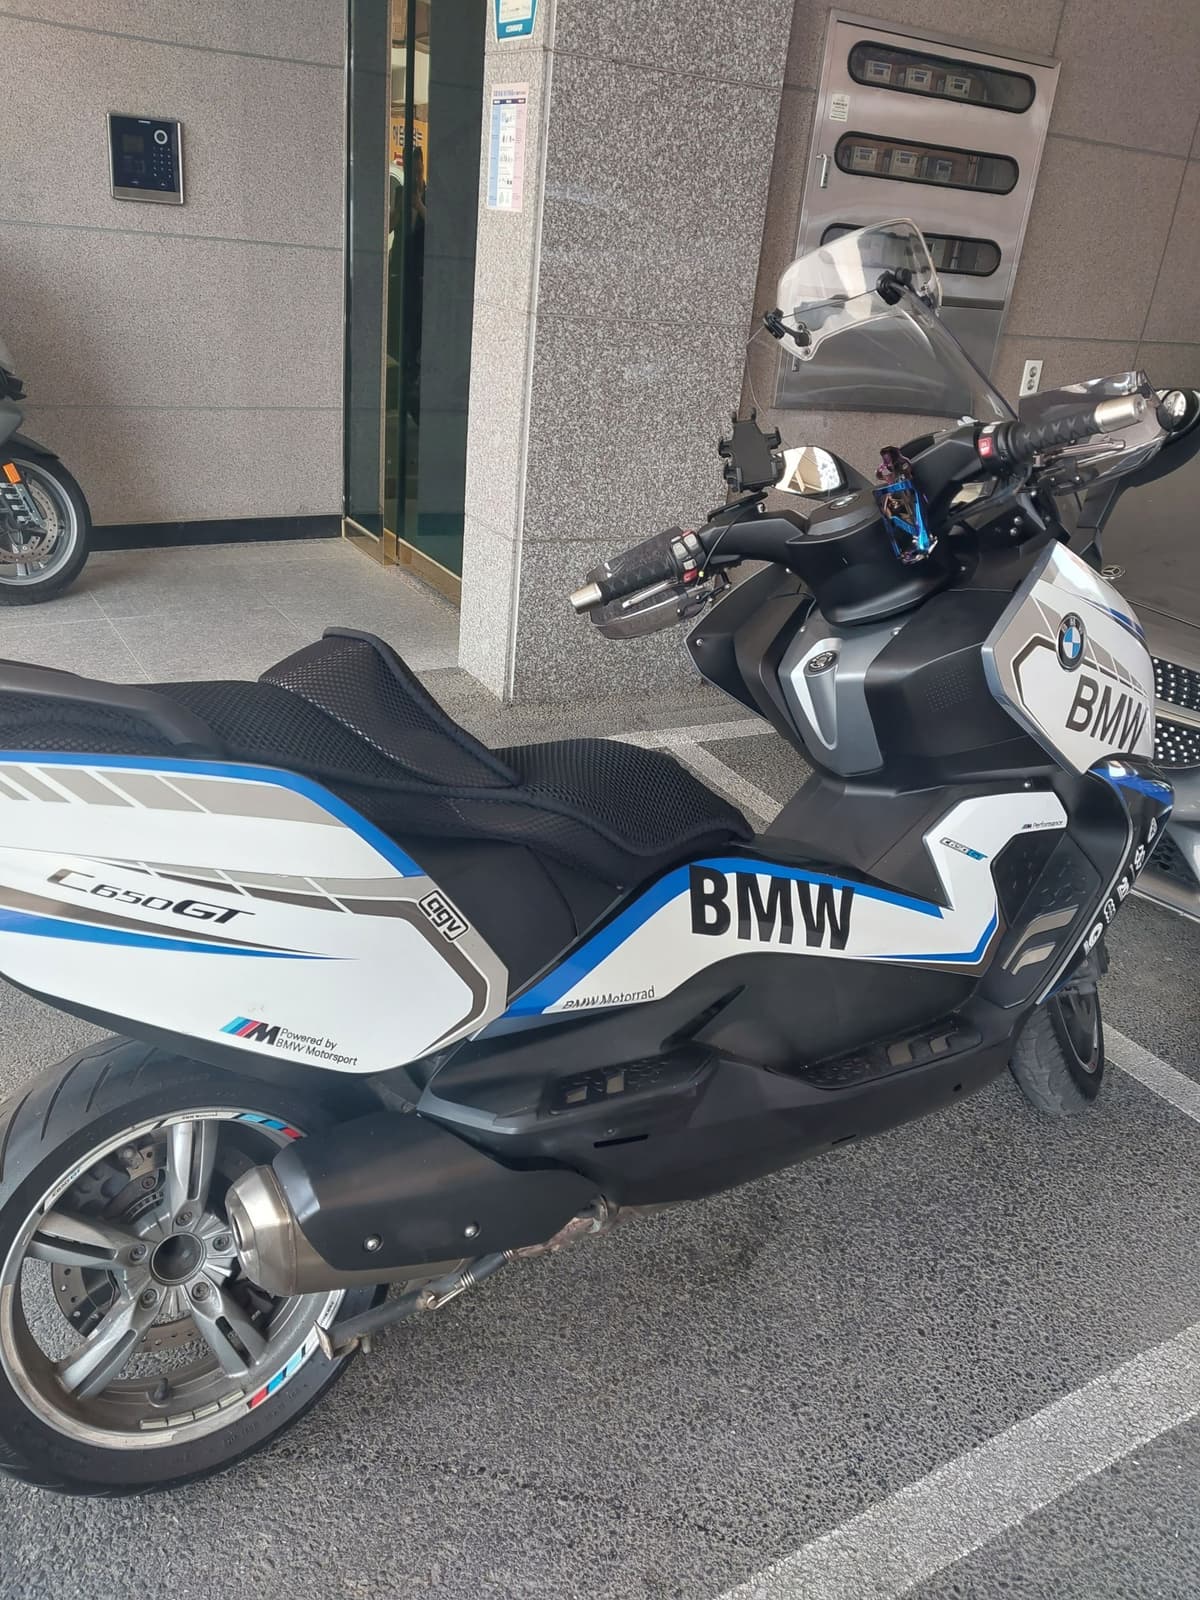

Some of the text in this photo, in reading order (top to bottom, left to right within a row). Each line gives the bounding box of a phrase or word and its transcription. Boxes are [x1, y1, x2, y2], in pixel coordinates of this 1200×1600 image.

[1065, 673, 1149, 755] BMW
[47, 868, 256, 924] C650GT
[690, 863, 855, 950] BMW
[562, 985, 655, 1010] BMW Motorrad
[276, 1038, 358, 1066] BMW Motorsport
[280, 1028, 338, 1051] Powered by
